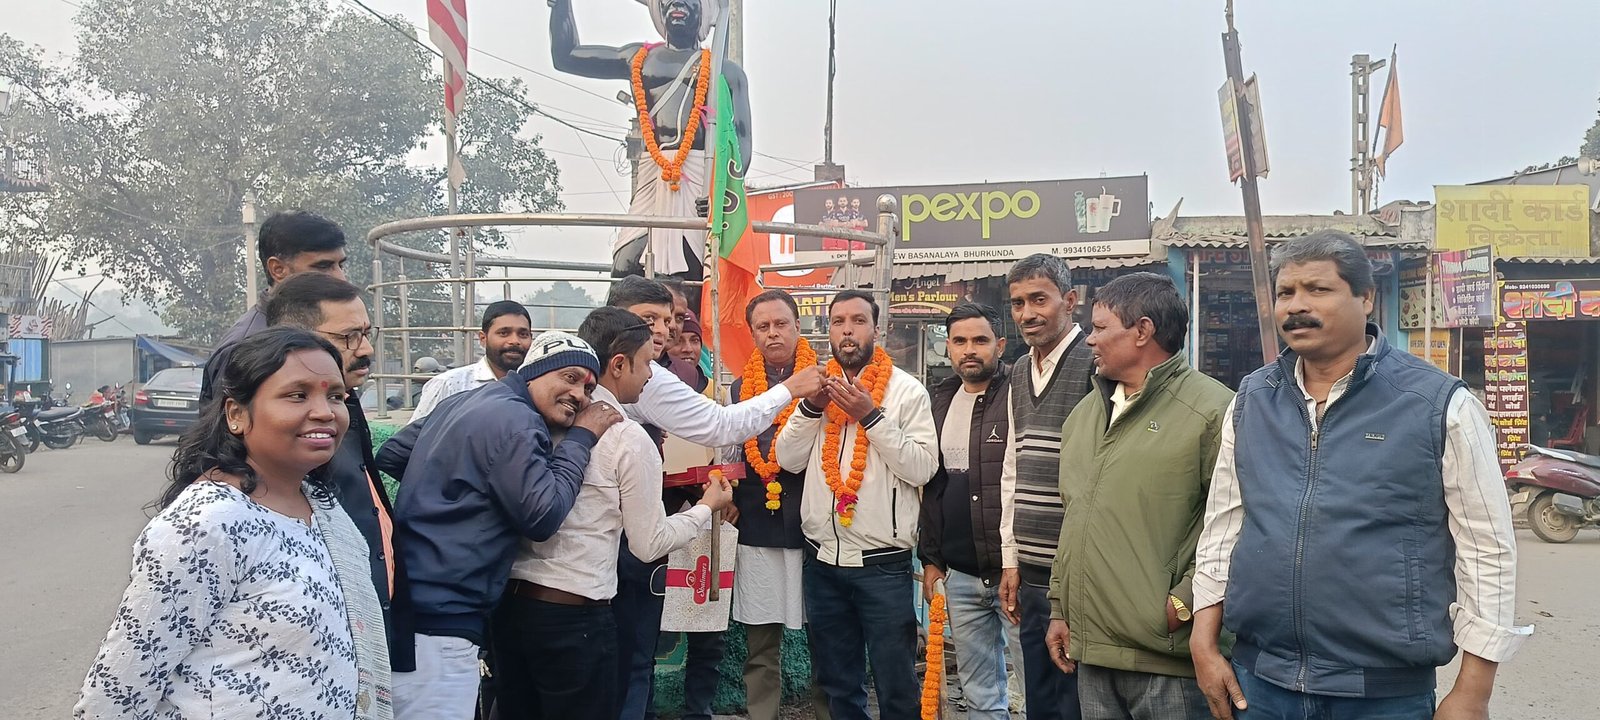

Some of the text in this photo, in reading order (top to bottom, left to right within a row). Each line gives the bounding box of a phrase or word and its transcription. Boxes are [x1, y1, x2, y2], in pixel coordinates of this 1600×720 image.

[902, 189, 1041, 242] pexpo
[1440, 190, 1586, 222] शादी कार्ड
[1466, 224, 1562, 247] विक्रेता
[892, 251, 906, 260] EW
[908, 251, 959, 260] BASANALAYA
[964, 249, 1014, 258] BHURKUNDA
[1063, 245, 1111, 254] 9934106255
[904, 278, 941, 290] Angel
[917, 291, 958, 302] Parlour
[1503, 282, 1577, 320] शादी
[543, 339, 595, 355] PU
